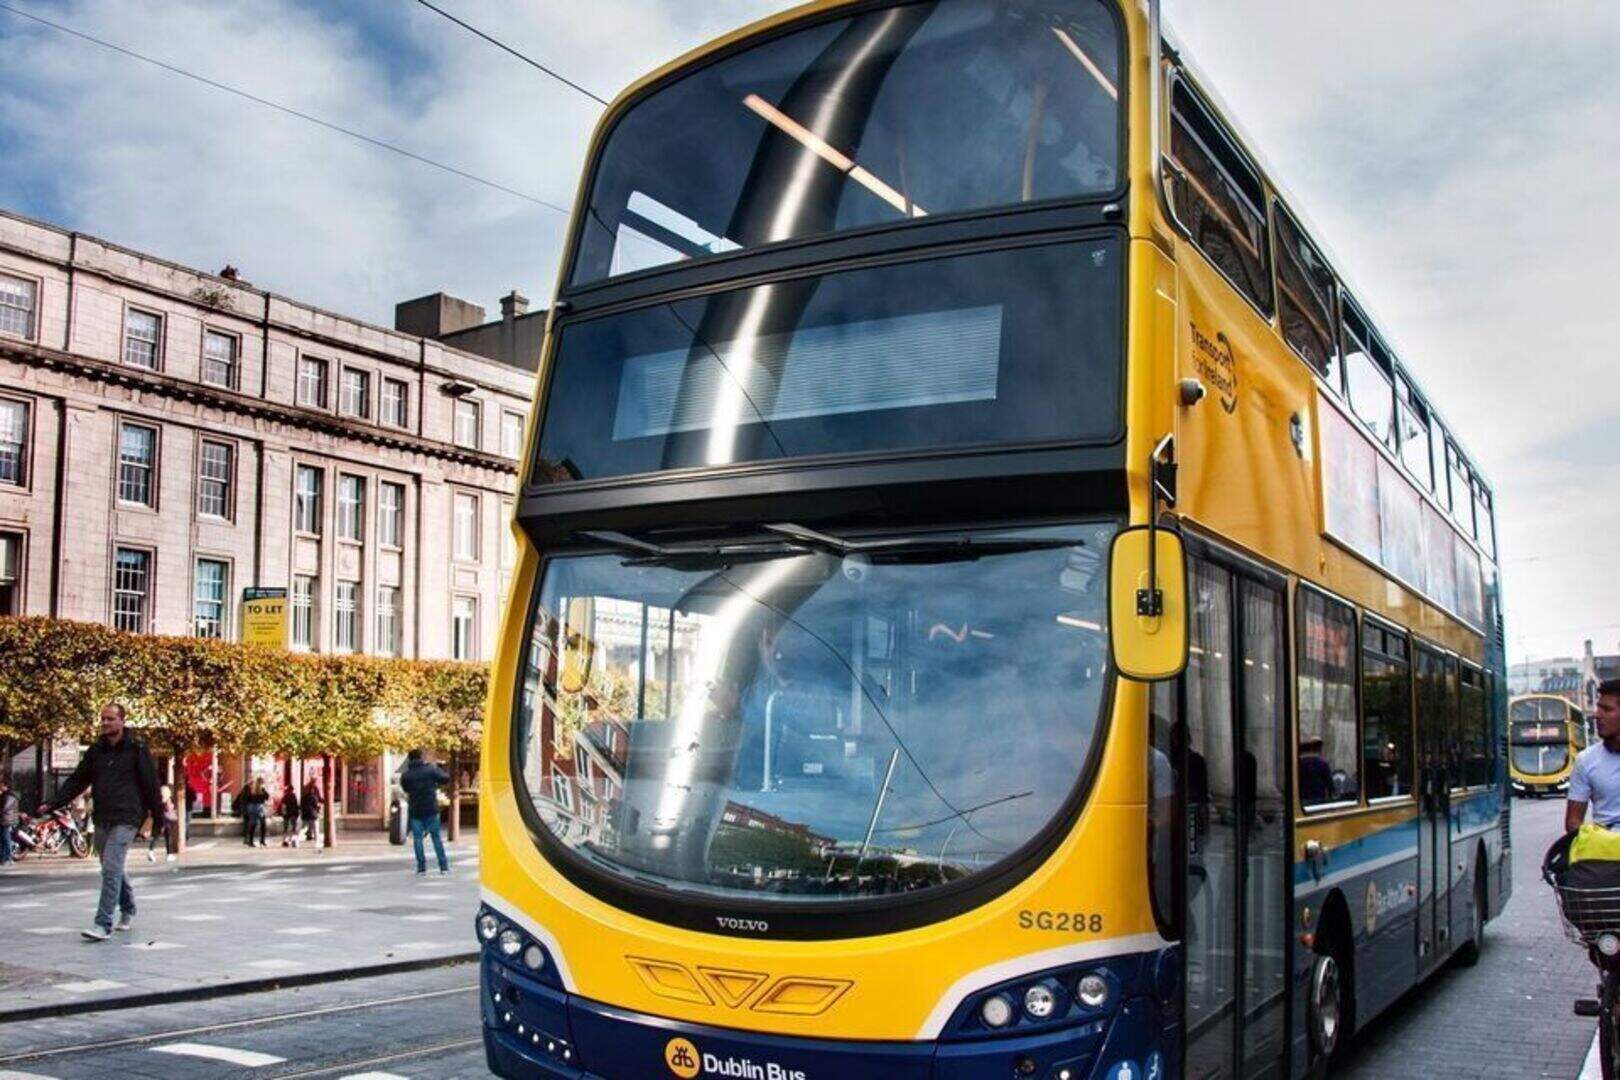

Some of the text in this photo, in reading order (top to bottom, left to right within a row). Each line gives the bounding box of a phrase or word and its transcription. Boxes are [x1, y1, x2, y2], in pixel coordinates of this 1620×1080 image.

[248, 605, 282, 615] TO LET
[716, 916, 769, 932] VOLVO
[1018, 910, 1103, 933] SG288
[703, 1053, 806, 1080] Dublin Bus
